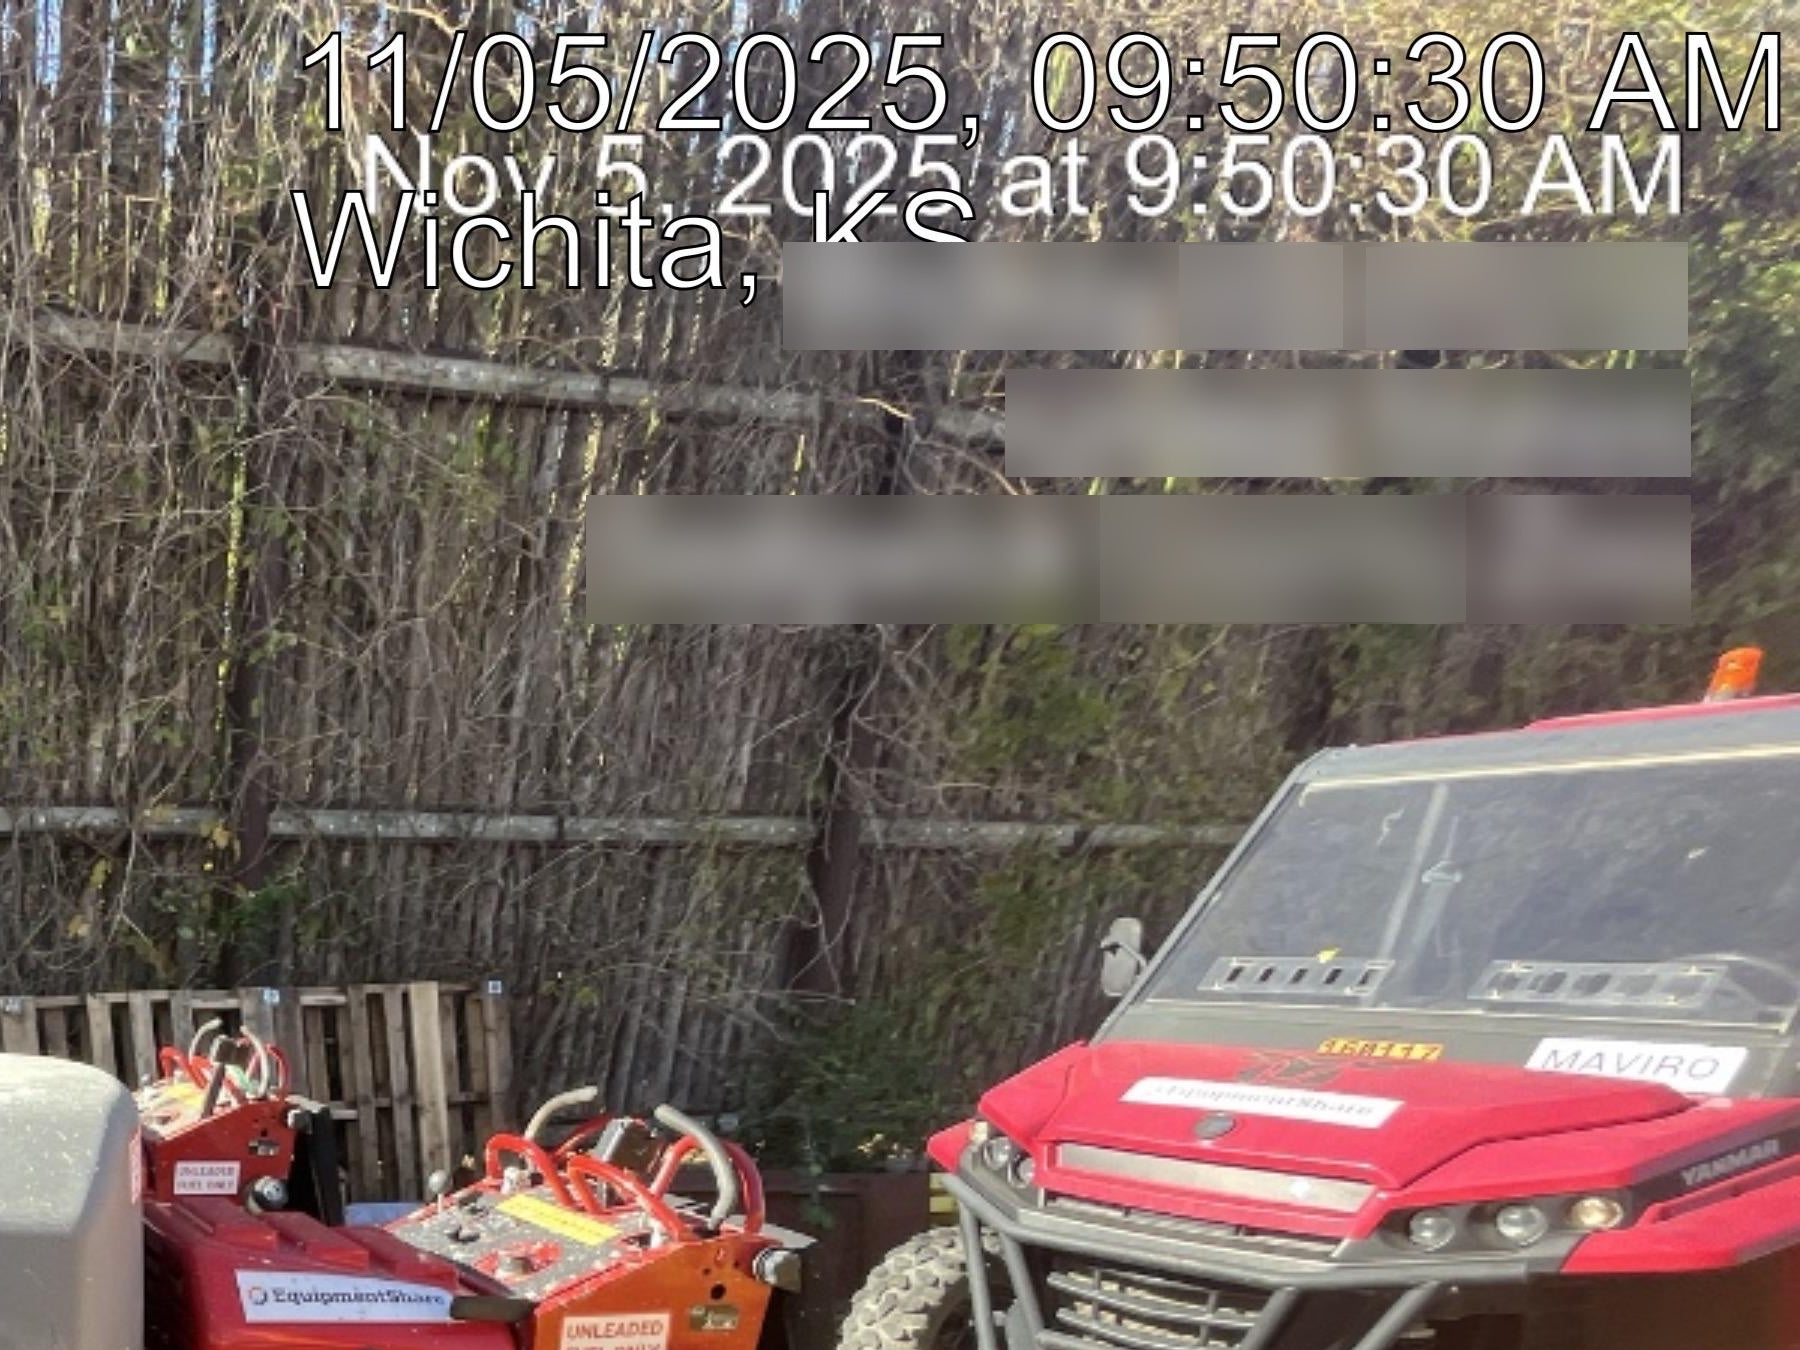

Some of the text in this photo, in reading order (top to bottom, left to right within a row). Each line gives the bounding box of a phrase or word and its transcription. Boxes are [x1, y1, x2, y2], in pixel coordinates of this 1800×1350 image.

[1541, 1048, 1720, 1080] MAVIRO
[1681, 1138, 1781, 1186] YANMAR
[272, 1286, 445, 1306] EquipmentShare
[566, 1320, 664, 1340] UNLEADED
